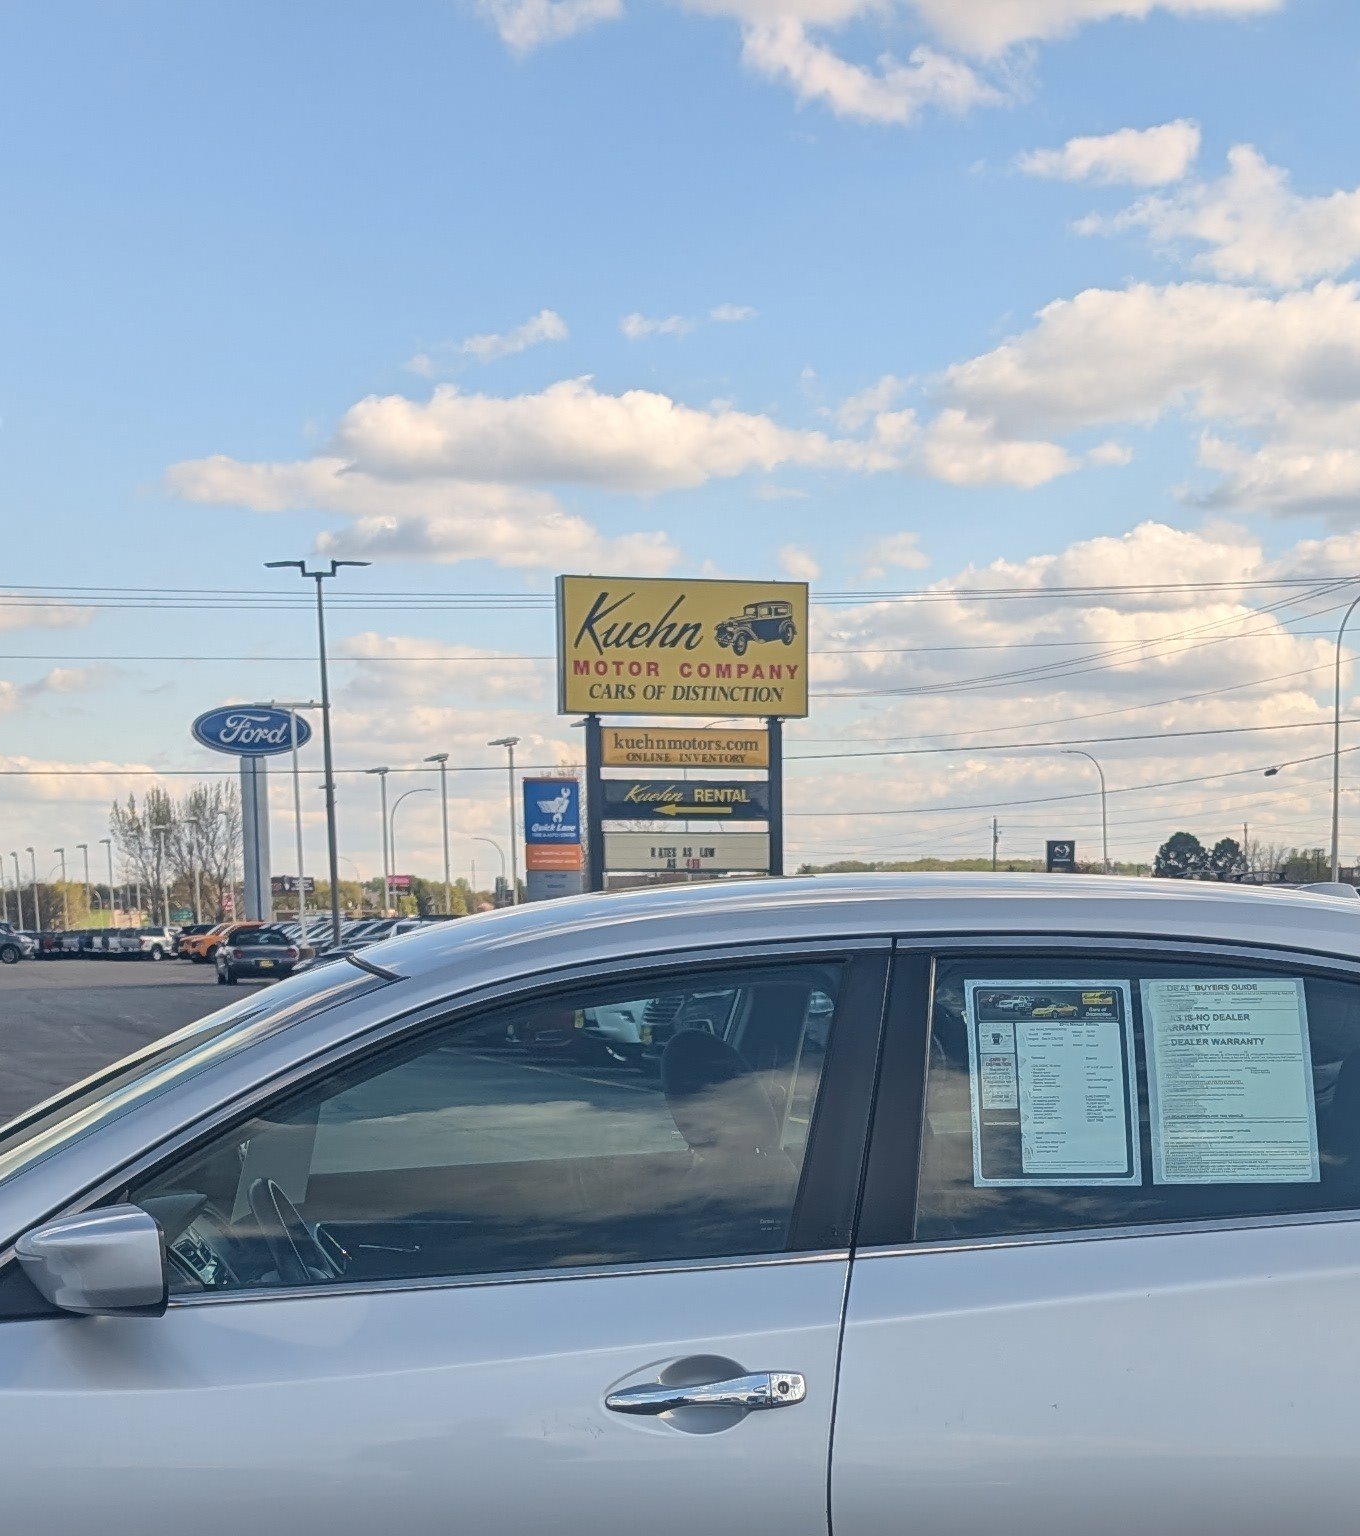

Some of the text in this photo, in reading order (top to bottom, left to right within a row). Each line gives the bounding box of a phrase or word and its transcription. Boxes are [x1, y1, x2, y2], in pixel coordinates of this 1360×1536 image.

[574, 592, 704, 655] Kuehn
[573, 660, 799, 680] MOTOR COMPANY
[589, 683, 785, 702] CARS OF DISTINCTION
[220, 714, 288, 744] Ford
[613, 732, 759, 751] kuehnmotors.com
[626, 752, 747, 764] ONLINE INVENTORY
[624, 784, 751, 803] Kuehn RENTAL
[532, 823, 577, 832] Quick Lane
[1213, 1013, 1250, 1021] DEALER
[1170, 1037, 1265, 1046] DEALER WARRANTY
